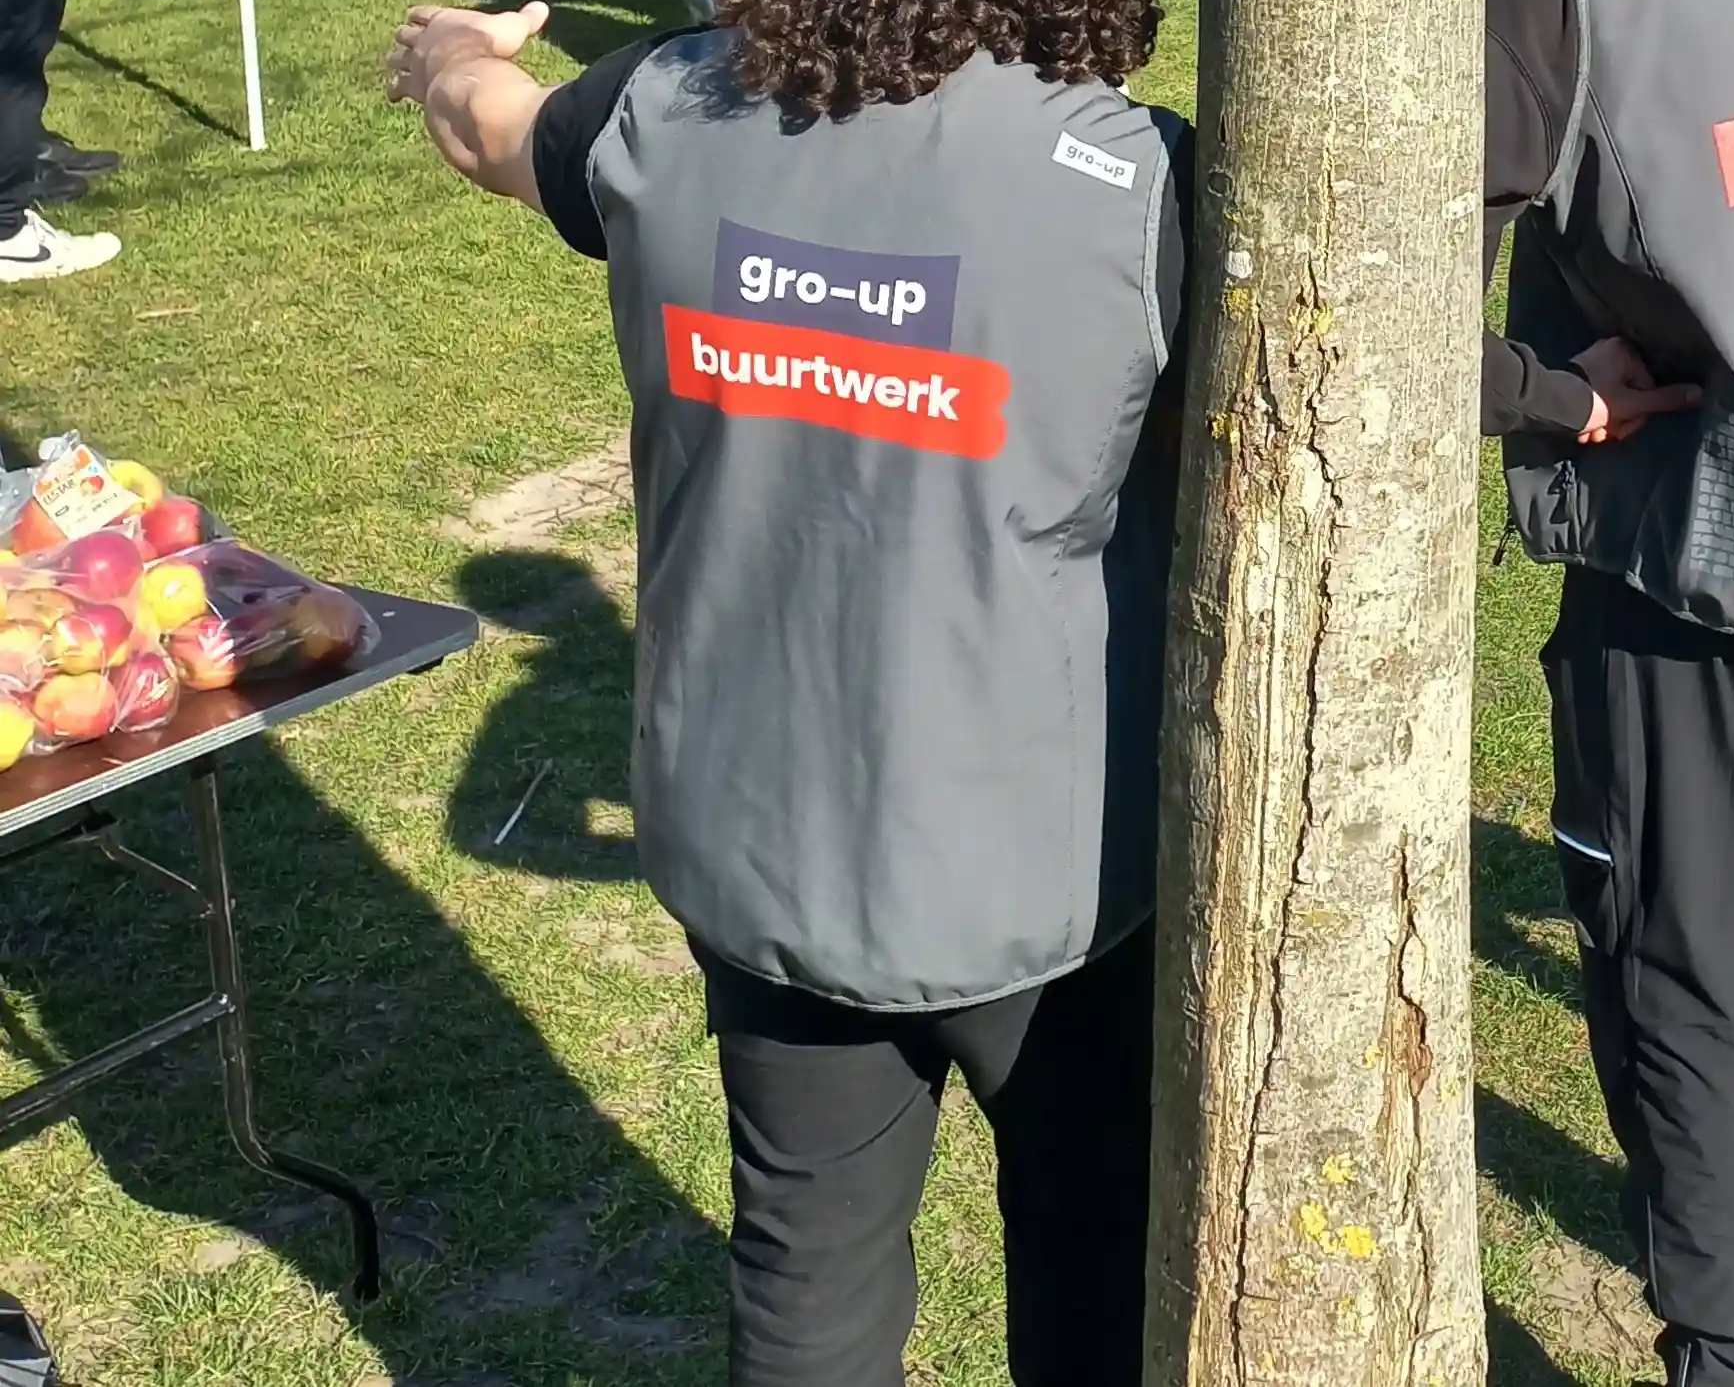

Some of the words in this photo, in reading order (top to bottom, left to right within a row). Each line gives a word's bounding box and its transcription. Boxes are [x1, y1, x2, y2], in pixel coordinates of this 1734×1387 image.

[1066, 145, 1126, 178] gro-up
[739, 254, 927, 326] gro-up
[691, 332, 961, 421] buurtwerk
